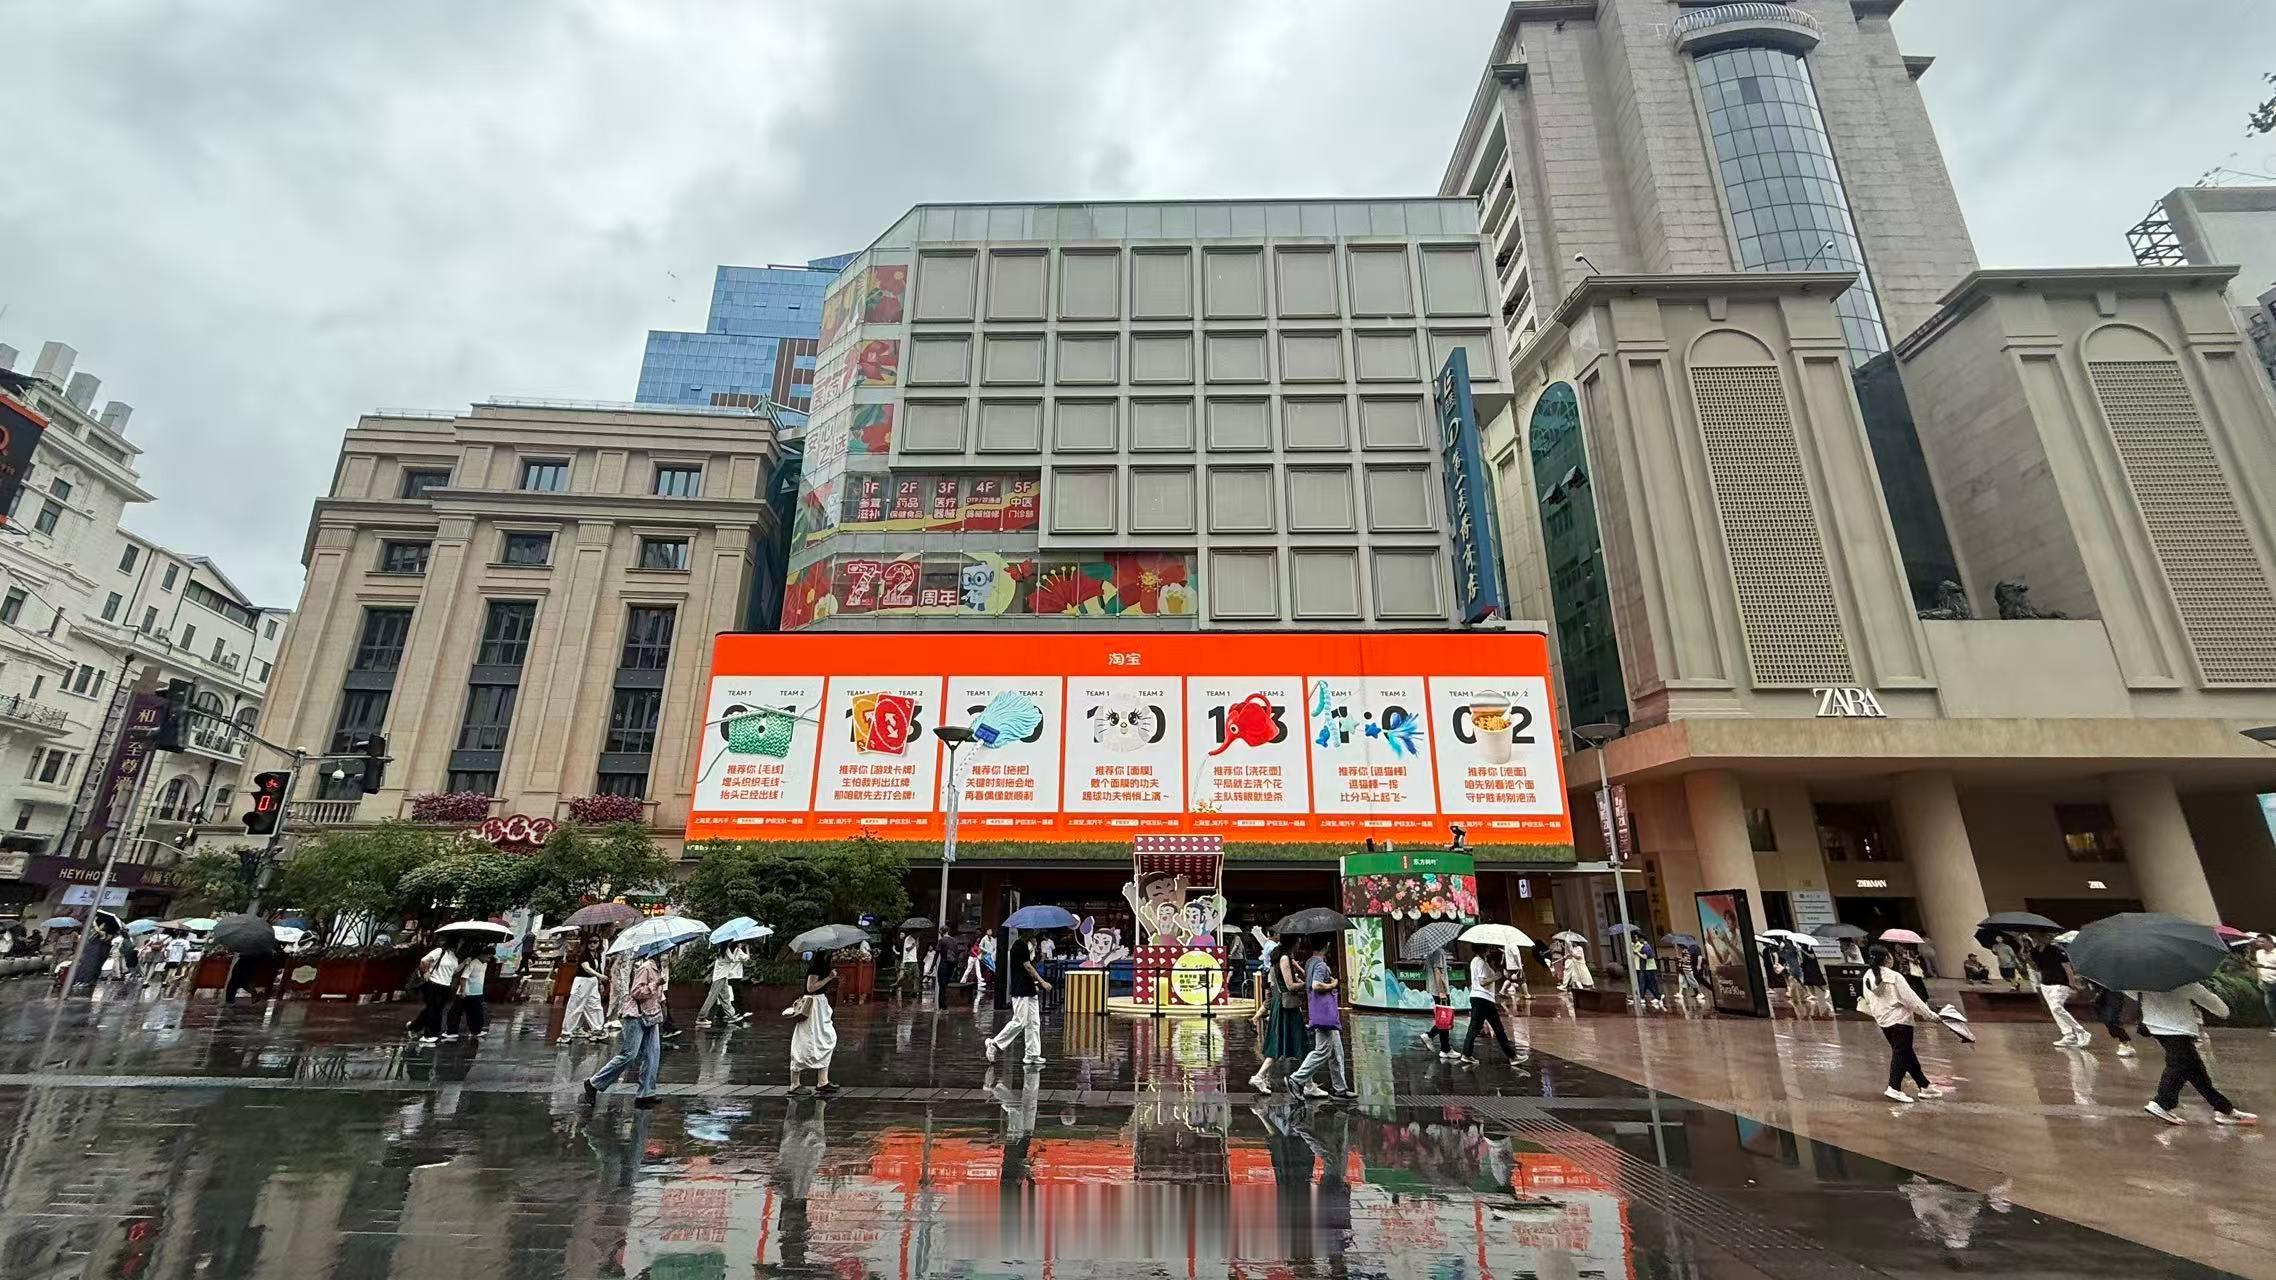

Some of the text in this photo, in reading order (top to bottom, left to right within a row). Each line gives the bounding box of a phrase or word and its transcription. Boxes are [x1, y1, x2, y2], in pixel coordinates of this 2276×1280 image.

[865, 482, 879, 494] 1F
[901, 482, 917, 494] 2F
[938, 482, 955, 494] 3F
[976, 482, 993, 494] 4F
[1015, 482, 1031, 494] 5F
[897, 498, 918, 508] 药品
[934, 497, 955, 508] 医疗
[1010, 497, 1032, 508] 中医
[858, 509, 880, 519] 滋补
[933, 509, 956, 519] 器械
[921, 589, 957, 606] 周年
[1109, 653, 1141, 665] 淘宝
[1813, 687, 1888, 717] ZARA
[727, 764, 756, 774] 推荐你
[839, 765, 868, 774] 推荐你
[972, 765, 1001, 775] 推荐你
[1095, 765, 1124, 775] 推荐你
[1214, 766, 1243, 775] 推荐你
[1339, 766, 1368, 776] 推荐你
[1468, 766, 1497, 776] 推荐你
[59, 868, 118, 882] HEYI HOEL
